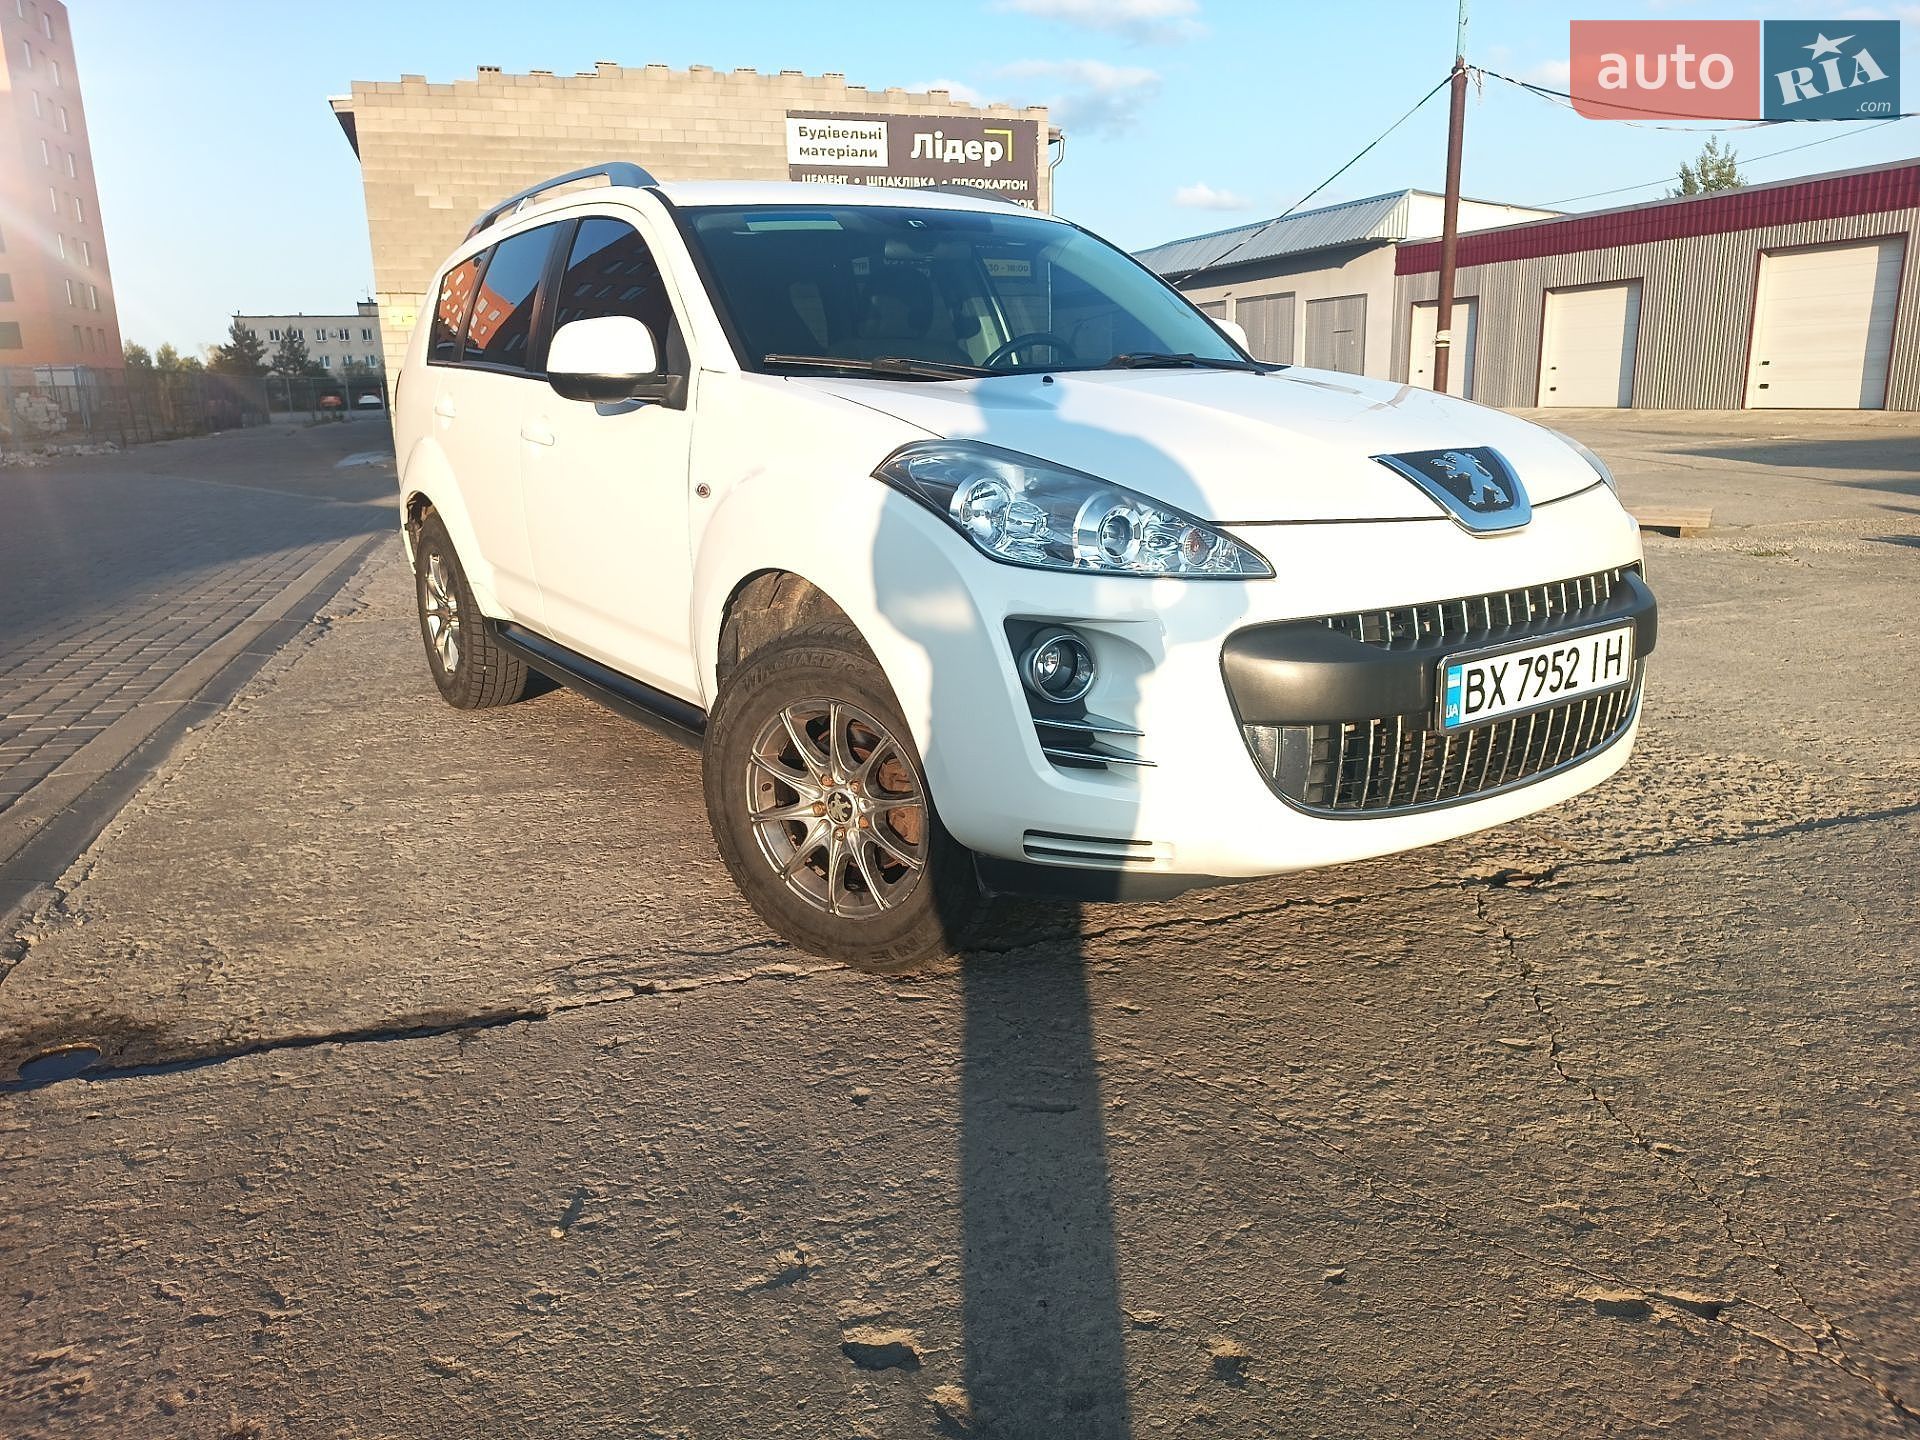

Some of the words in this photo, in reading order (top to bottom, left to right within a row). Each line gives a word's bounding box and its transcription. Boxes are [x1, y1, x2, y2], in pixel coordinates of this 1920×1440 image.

[798, 125, 882, 140] Будівельні
[799, 145, 878, 159] матеріали
[910, 130, 1004, 167] Лідер
[801, 173, 849, 185] ЦЕМЕНТ
[866, 175, 936, 188] ШПАКЛІВКА
[1465, 661, 1509, 715] BX
[1517, 647, 1580, 702] 7952
[1592, 635, 1623, 683] IH
